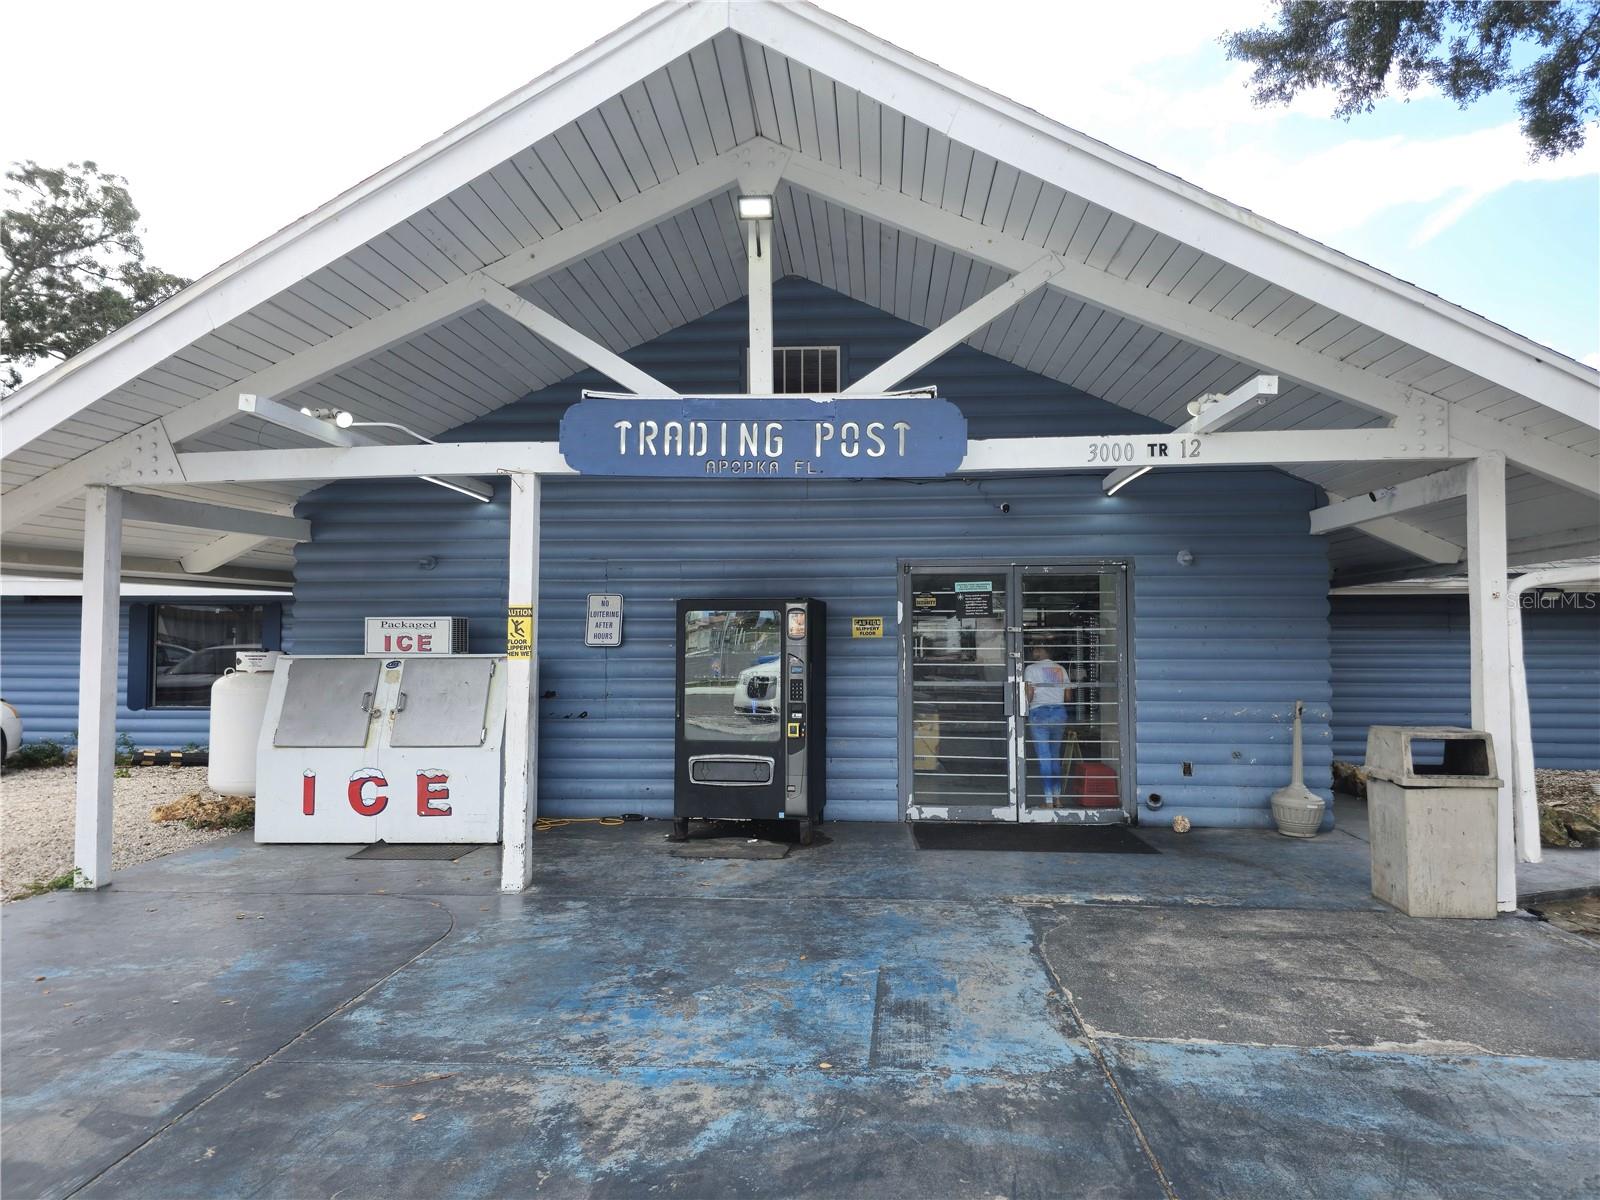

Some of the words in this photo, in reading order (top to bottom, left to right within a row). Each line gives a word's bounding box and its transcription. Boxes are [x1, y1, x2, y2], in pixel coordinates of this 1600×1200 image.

[614, 421, 783, 458] TRADING
[815, 421, 911, 458] POST
[1088, 443, 1134, 462] 3000
[1147, 443, 1168, 457] TR
[1180, 438, 1202, 459] 12
[705, 460, 779, 474] APOPKA
[601, 599, 610, 607] NO
[590, 610, 619, 618] LOITERING
[381, 621, 437, 630] Packaged
[594, 621, 613, 629] AFTER
[593, 632, 613, 640] HOURS
[384, 634, 432, 652] ICE
[302, 768, 453, 817] ICE
